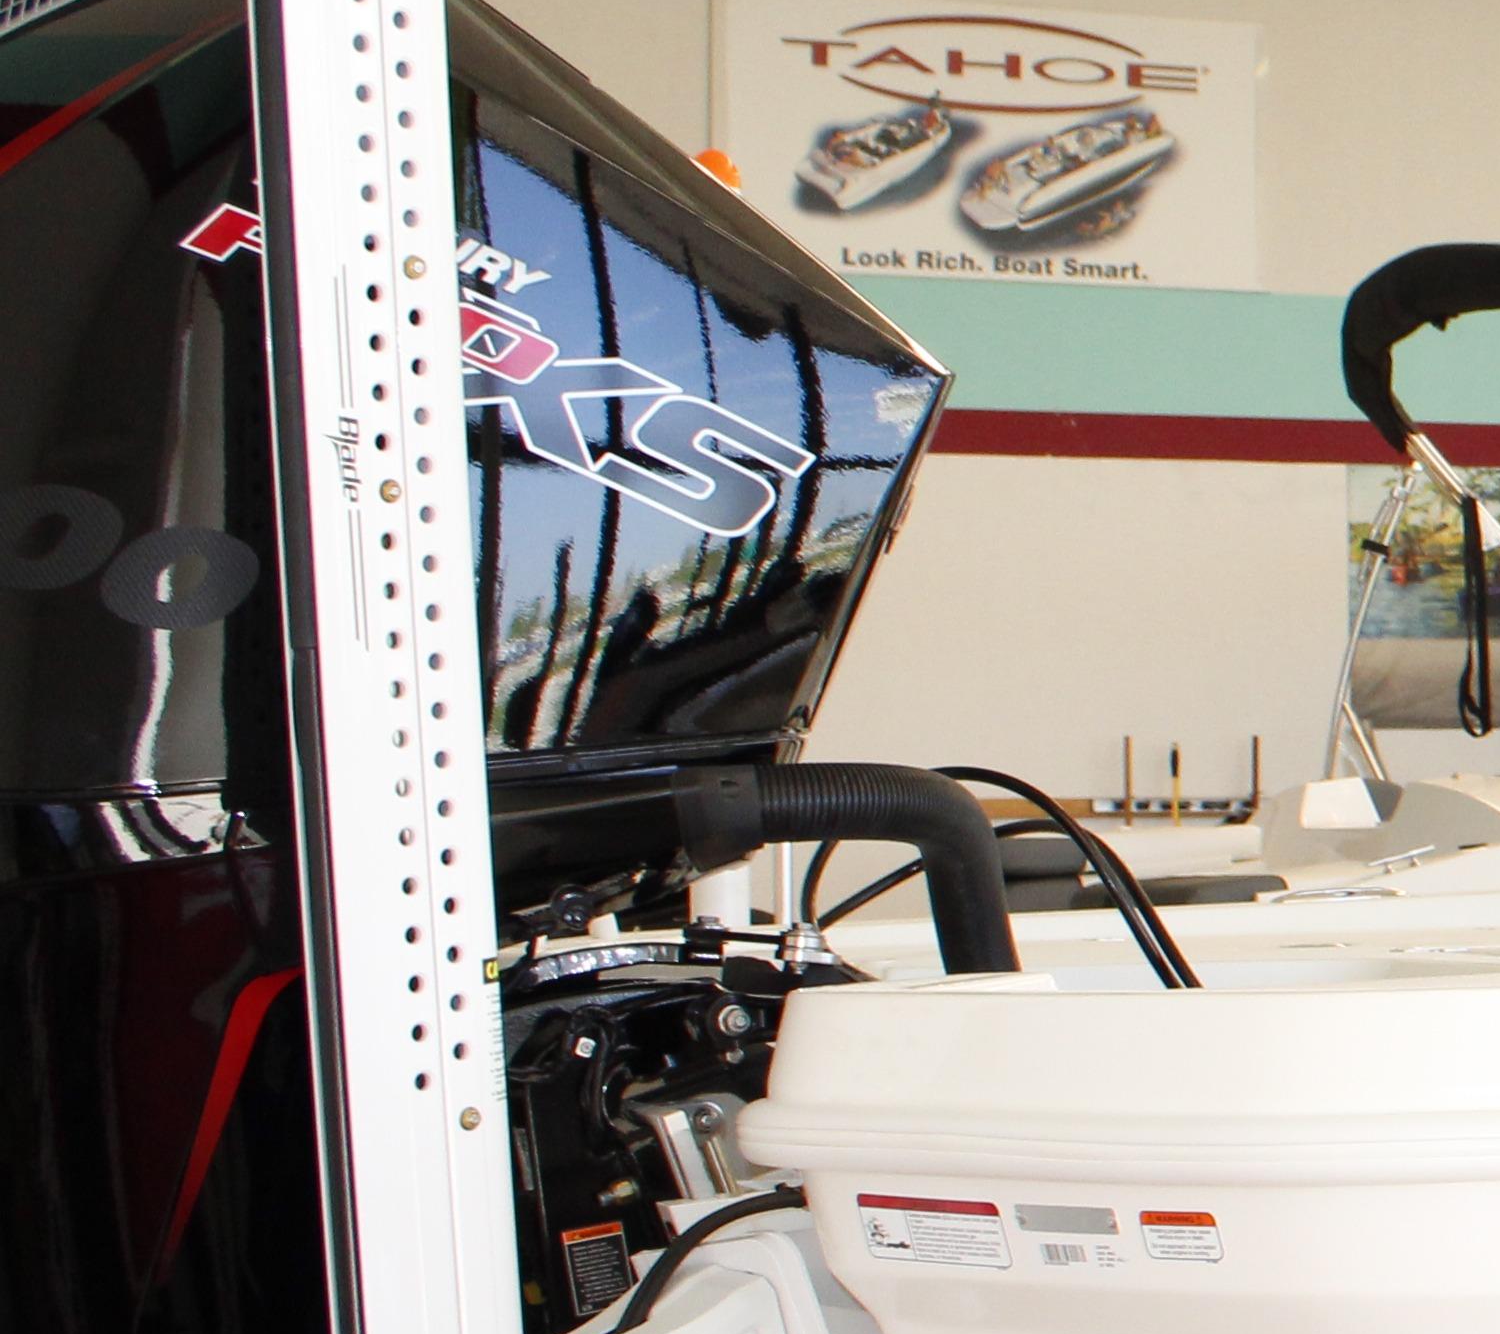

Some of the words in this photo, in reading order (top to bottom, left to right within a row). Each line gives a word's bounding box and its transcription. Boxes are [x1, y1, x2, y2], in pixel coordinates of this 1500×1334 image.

[780, 36, 1199, 94] TAHOE
[840, 245, 907, 270] Look
[914, 249, 984, 272] Rich.
[993, 255, 1053, 278] Boat
[1063, 257, 1150, 281] Smart.
[323, 413, 361, 504] Blade
